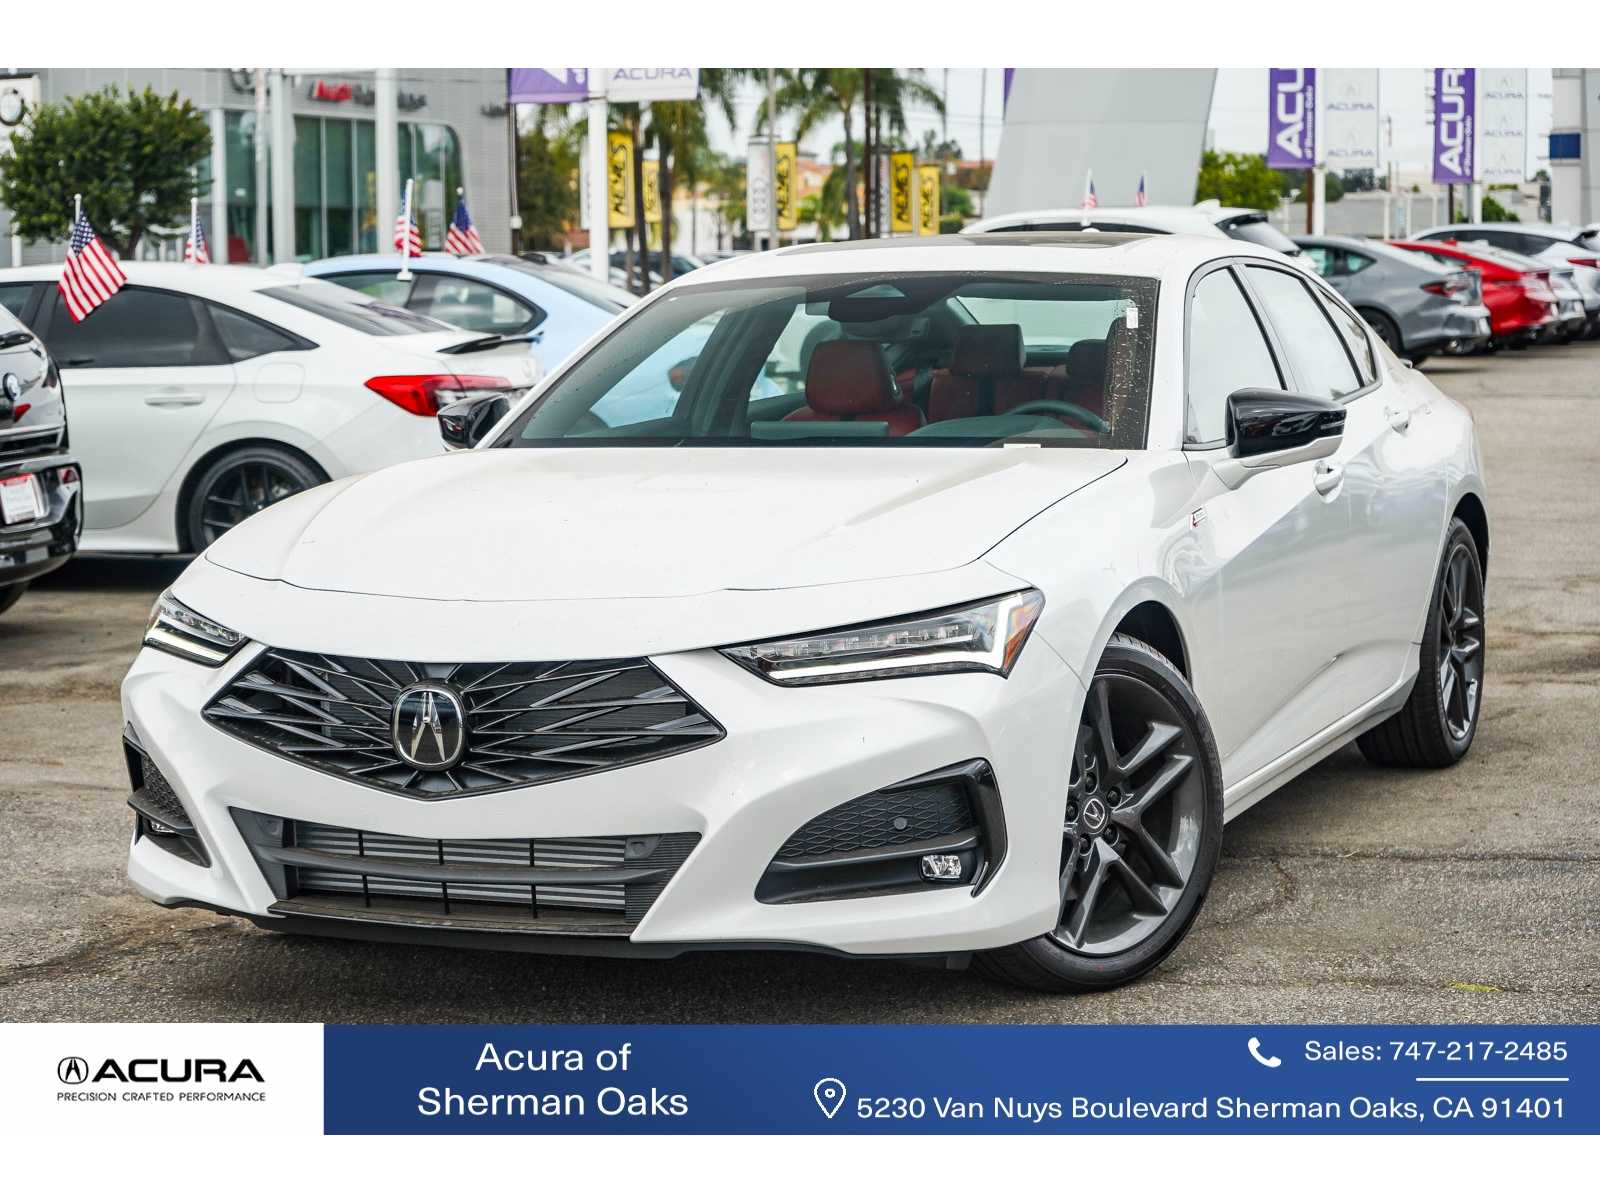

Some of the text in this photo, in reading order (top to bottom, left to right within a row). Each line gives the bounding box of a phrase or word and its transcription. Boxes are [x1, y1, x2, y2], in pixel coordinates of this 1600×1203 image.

[613, 68, 692, 81] ACURA
[1327, 102, 1375, 111] ACURA
[1439, 68, 1465, 176] ACUR
